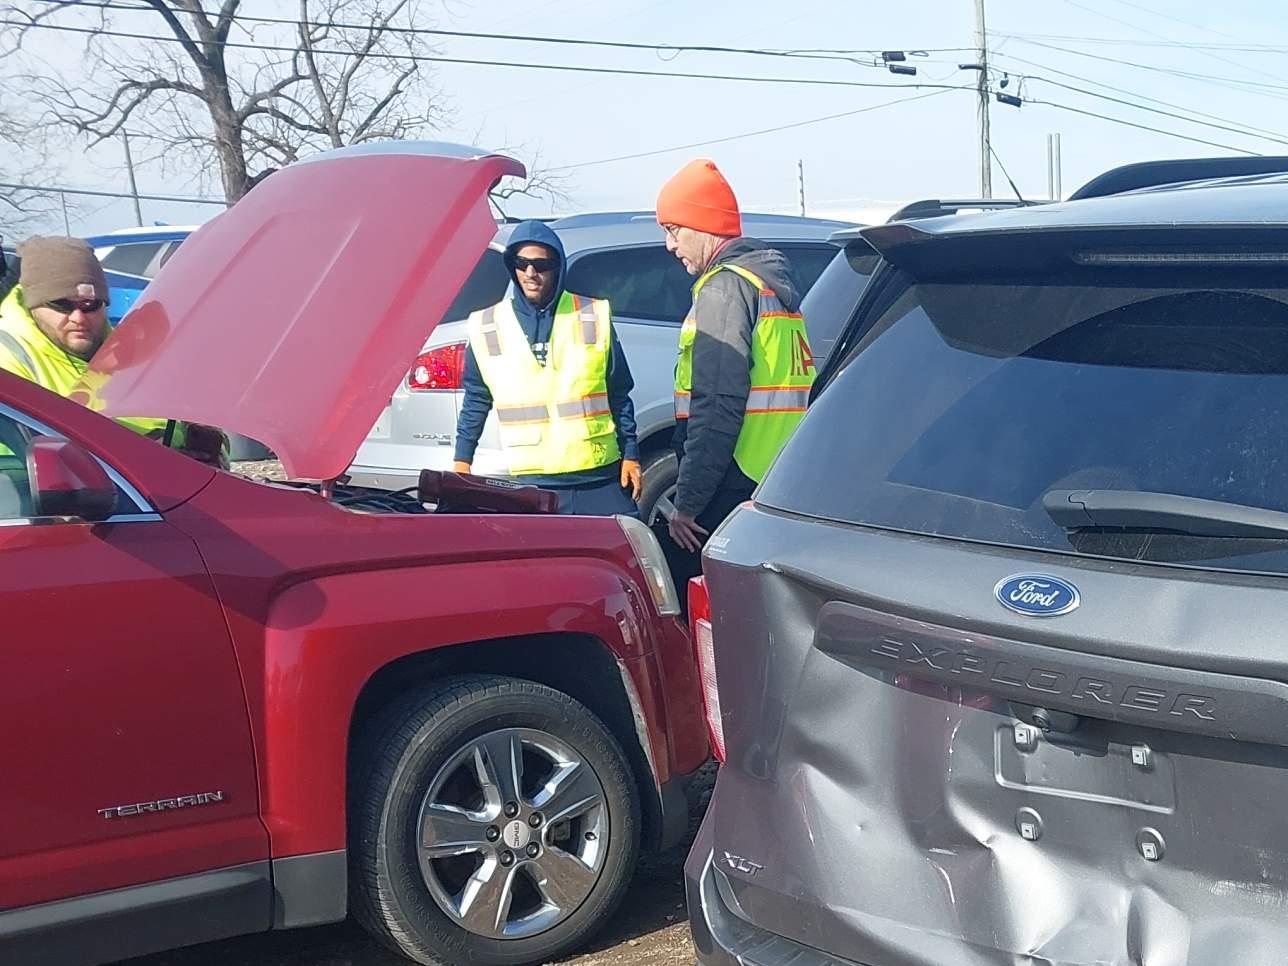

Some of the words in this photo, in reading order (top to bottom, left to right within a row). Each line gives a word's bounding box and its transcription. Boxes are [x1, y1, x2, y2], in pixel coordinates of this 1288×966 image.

[1009, 579, 1059, 607] Ford
[871, 638, 1216, 721] EXPLORER
[97, 790, 222, 819] TERRAIN
[720, 851, 766, 876] XLT
